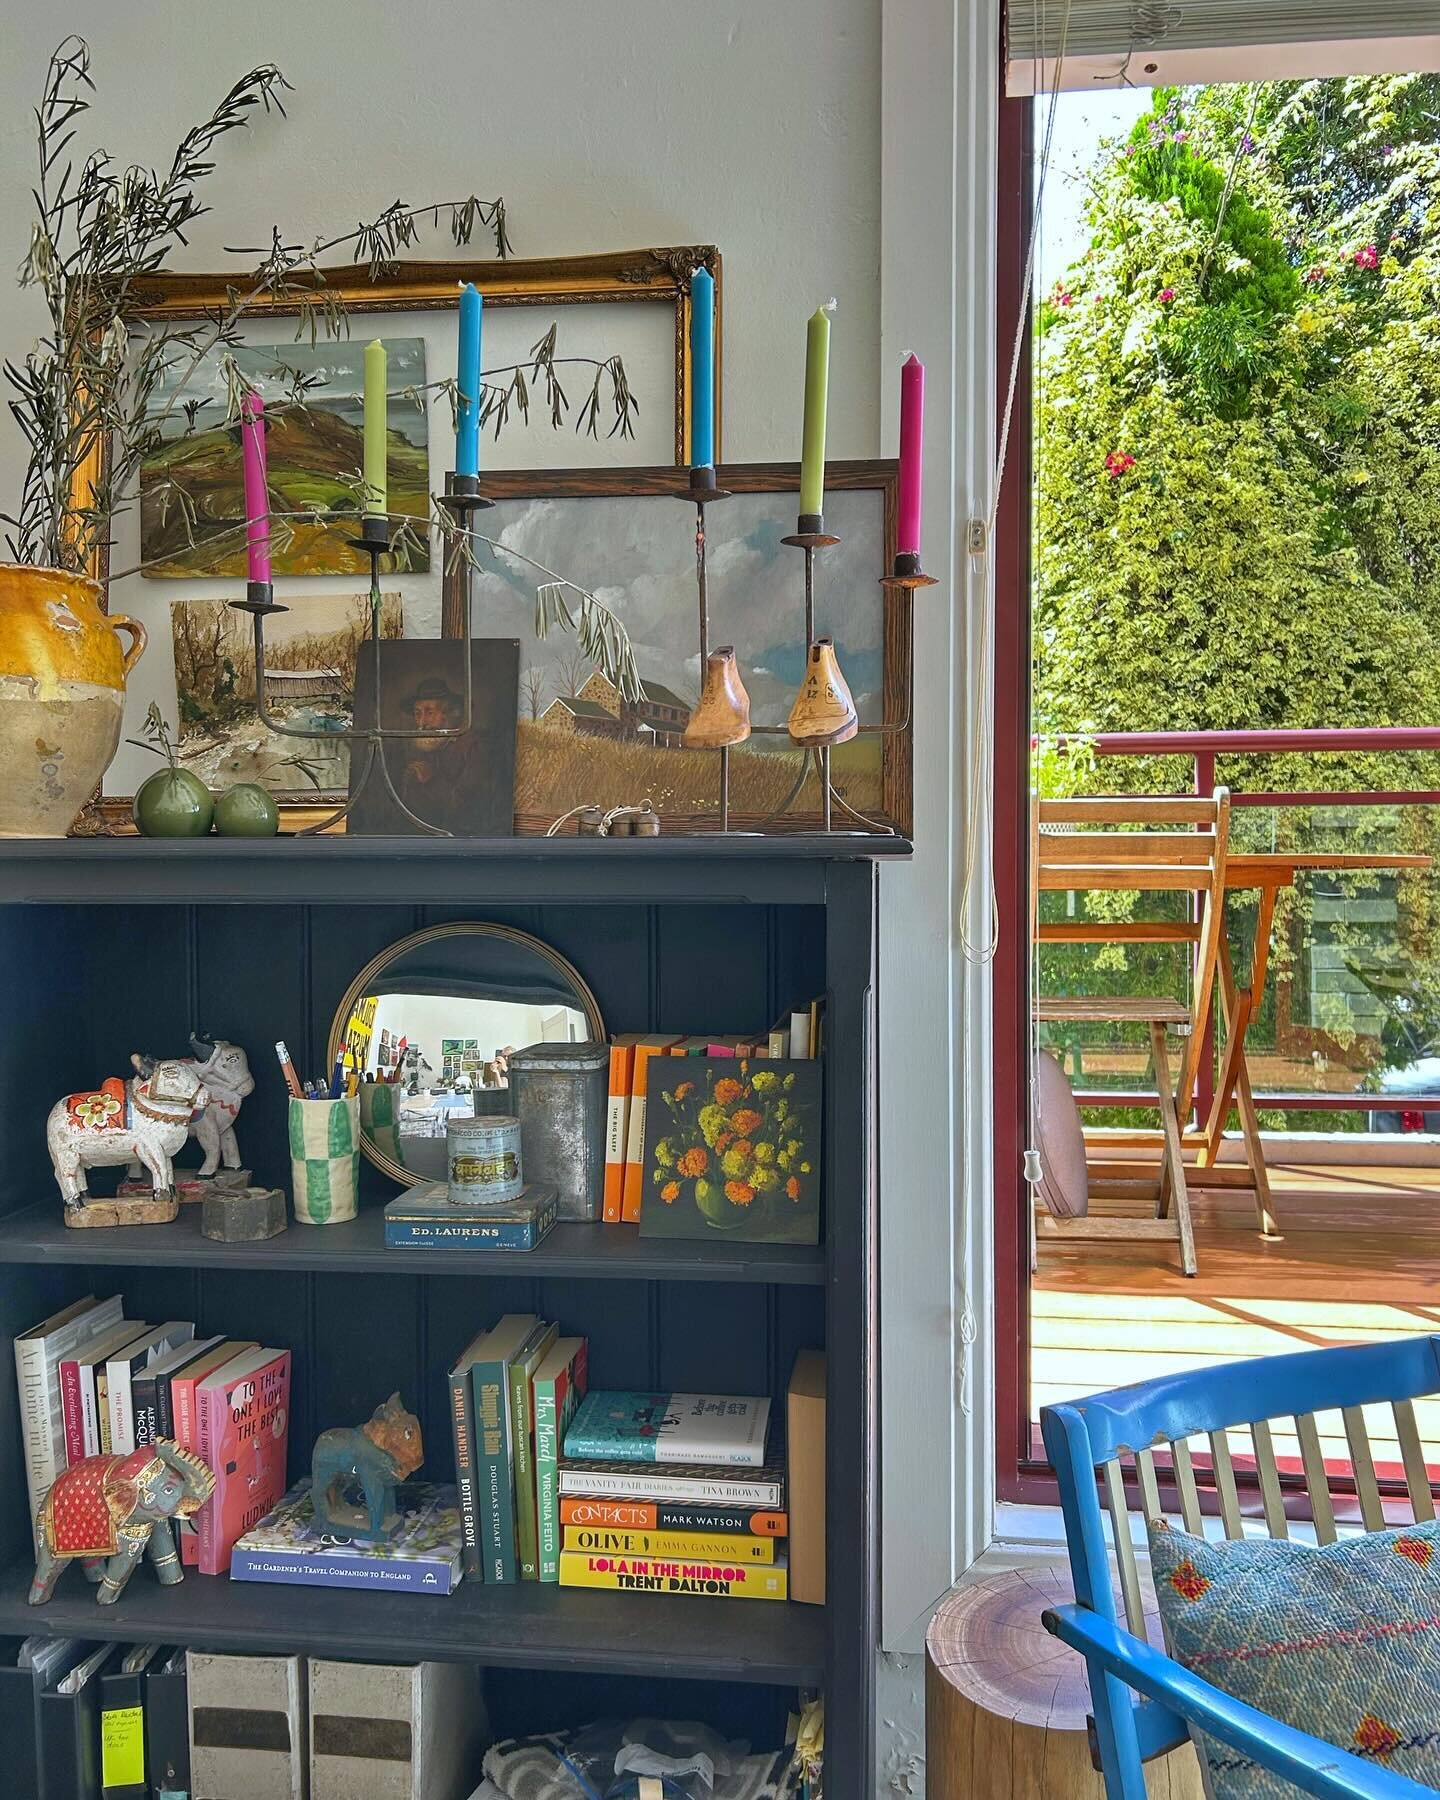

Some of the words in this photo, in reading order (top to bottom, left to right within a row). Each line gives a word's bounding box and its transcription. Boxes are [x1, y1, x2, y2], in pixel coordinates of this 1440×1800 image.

[435, 1227, 500, 1237] LAURENS
[22, 1350, 38, 1368] At
[66, 1371, 76, 1387] An
[243, 1381, 256, 1399] TO
[260, 1369, 276, 1391] THE
[24, 1373, 42, 1425] Home
[68, 1387, 79, 1431] Everlasting
[201, 1396, 208, 1405] TO
[232, 1401, 252, 1424] ONE
[257, 1397, 260, 1412] I
[264, 1384, 282, 1408] LOVE
[453, 1388, 465, 1422] DANIEL
[480, 1384, 500, 1428] Shuggie
[537, 1395, 555, 1420] Mrs
[29, 1431, 41, 1446] in
[41, 1418, 49, 1451] Maynard
[116, 1407, 124, 1440] PROMISE
[182, 1417, 190, 1443] PROJECT
[237, 1419, 257, 1442] THE
[261, 1406, 279, 1430] BEST
[71, 1431, 81, 1456] Meal
[456, 1424, 469, 1468] HANDLER
[483, 1431, 502, 1456] Bain
[537, 1422, 556, 1462] March
[31, 1454, 48, 1480] the
[461, 1478, 472, 1513] BOTTLE
[489, 1465, 499, 1510] DOUGLAS
[542, 1473, 552, 1521] VIRGINIA
[585, 1480, 617, 1488] VANITY
[644, 1483, 673, 1491] DIARIES
[702, 1485, 723, 1495] TINA
[726, 1487, 760, 1497] BROWN
[492, 1512, 501, 1548] STUART
[571, 1503, 648, 1524] CONTACTS
[663, 1514, 693, 1524] MARK
[696, 1516, 743, 1527] WATSON
[464, 1515, 475, 1547] GROVE
[543, 1522, 553, 1552] FEITO
[578, 1532, 635, 1551] OLIVE
[656, 1541, 687, 1551] EMMA
[691, 1543, 737, 1554] GANNON
[303, 1566, 328, 1575] TRAVEL
[329, 1567, 369, 1577] COMPANION
[380, 1571, 411, 1580] ENGLAND
[588, 1558, 630, 1574] LOLA
[632, 1559, 648, 1575] IN
[652, 1562, 681, 1578] THE
[683, 1565, 746, 1582] MIRROR
[617, 1574, 664, 1591] TRENT
[669, 1577, 730, 1594] DALTON
